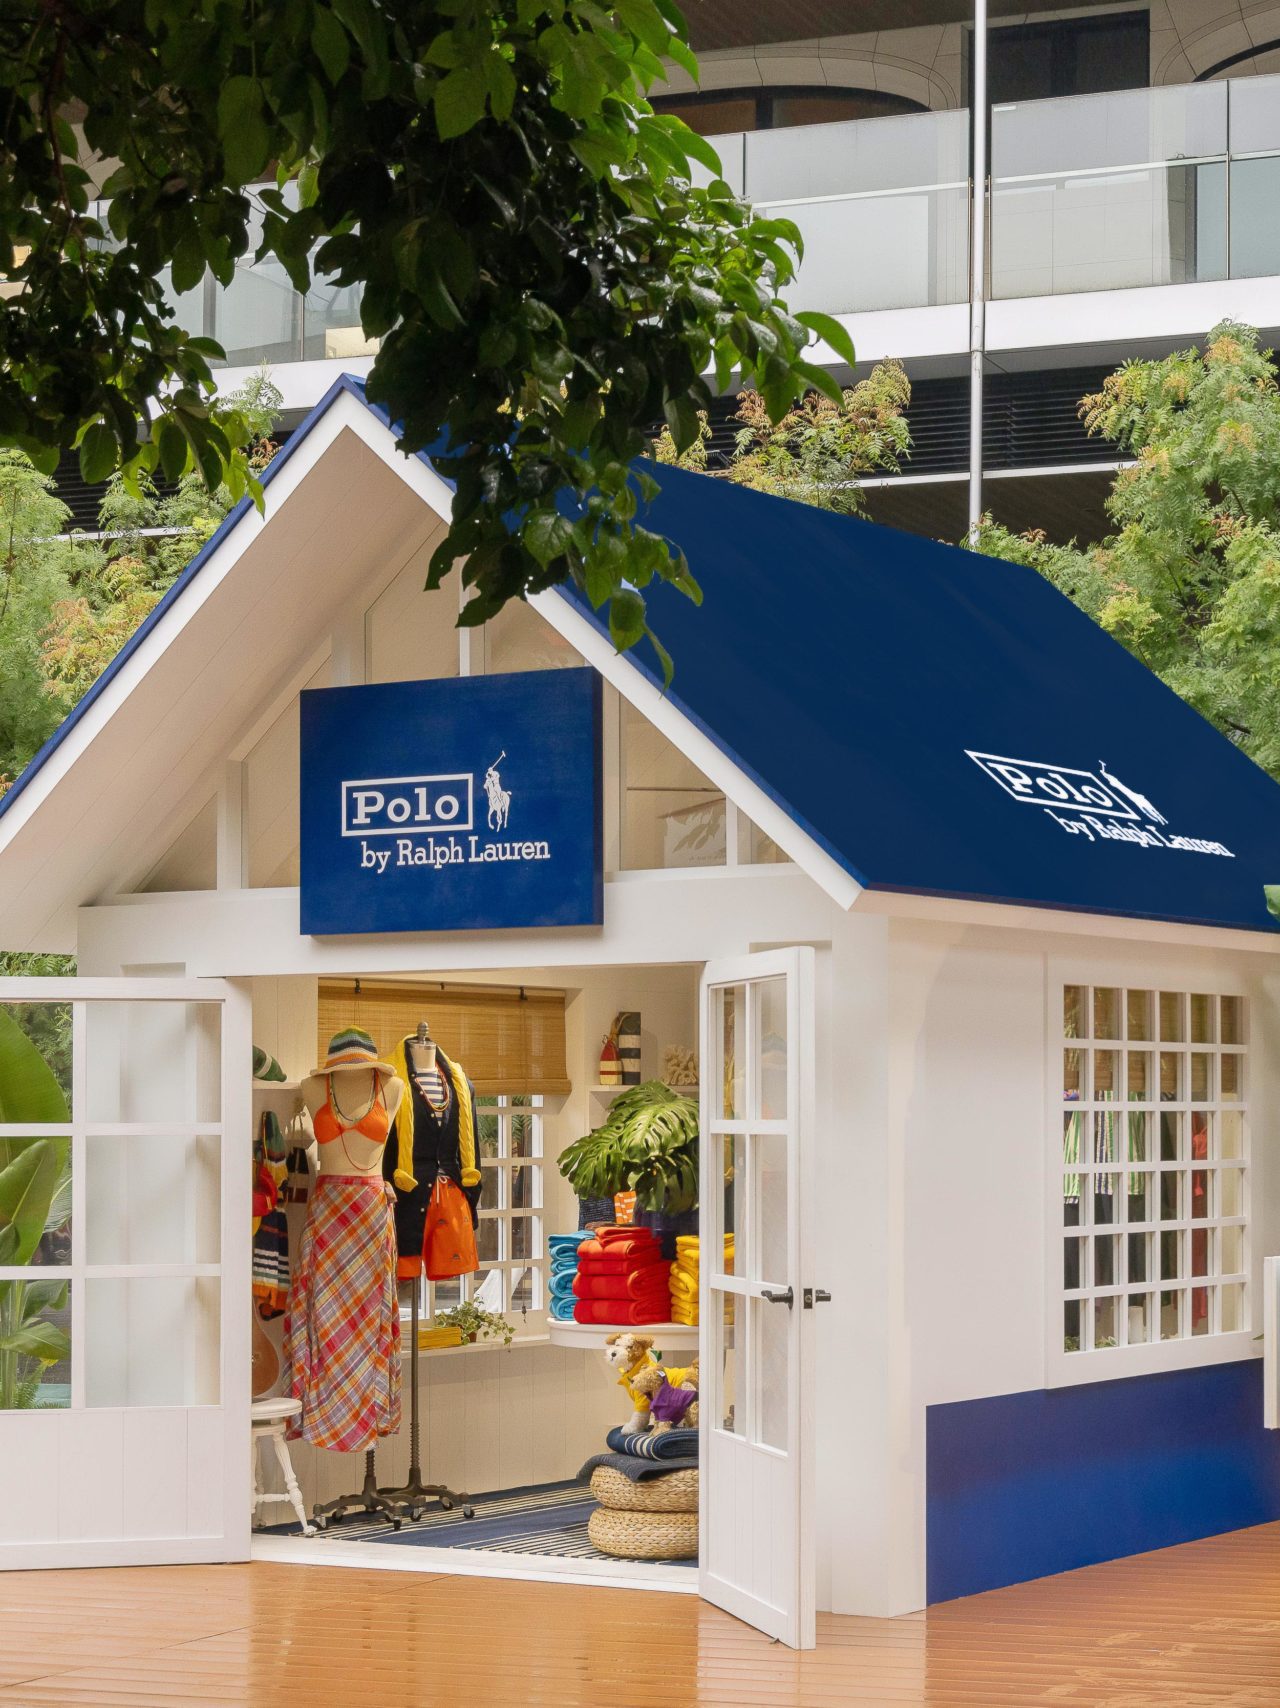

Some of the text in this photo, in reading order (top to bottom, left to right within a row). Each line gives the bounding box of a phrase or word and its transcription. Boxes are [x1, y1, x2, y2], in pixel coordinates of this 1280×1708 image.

[986, 761, 1113, 807] Polo
[352, 787, 460, 825] Polo
[1043, 808, 1236, 858] by Ralph Lauren
[360, 835, 551, 874] by Ralph Lauren
